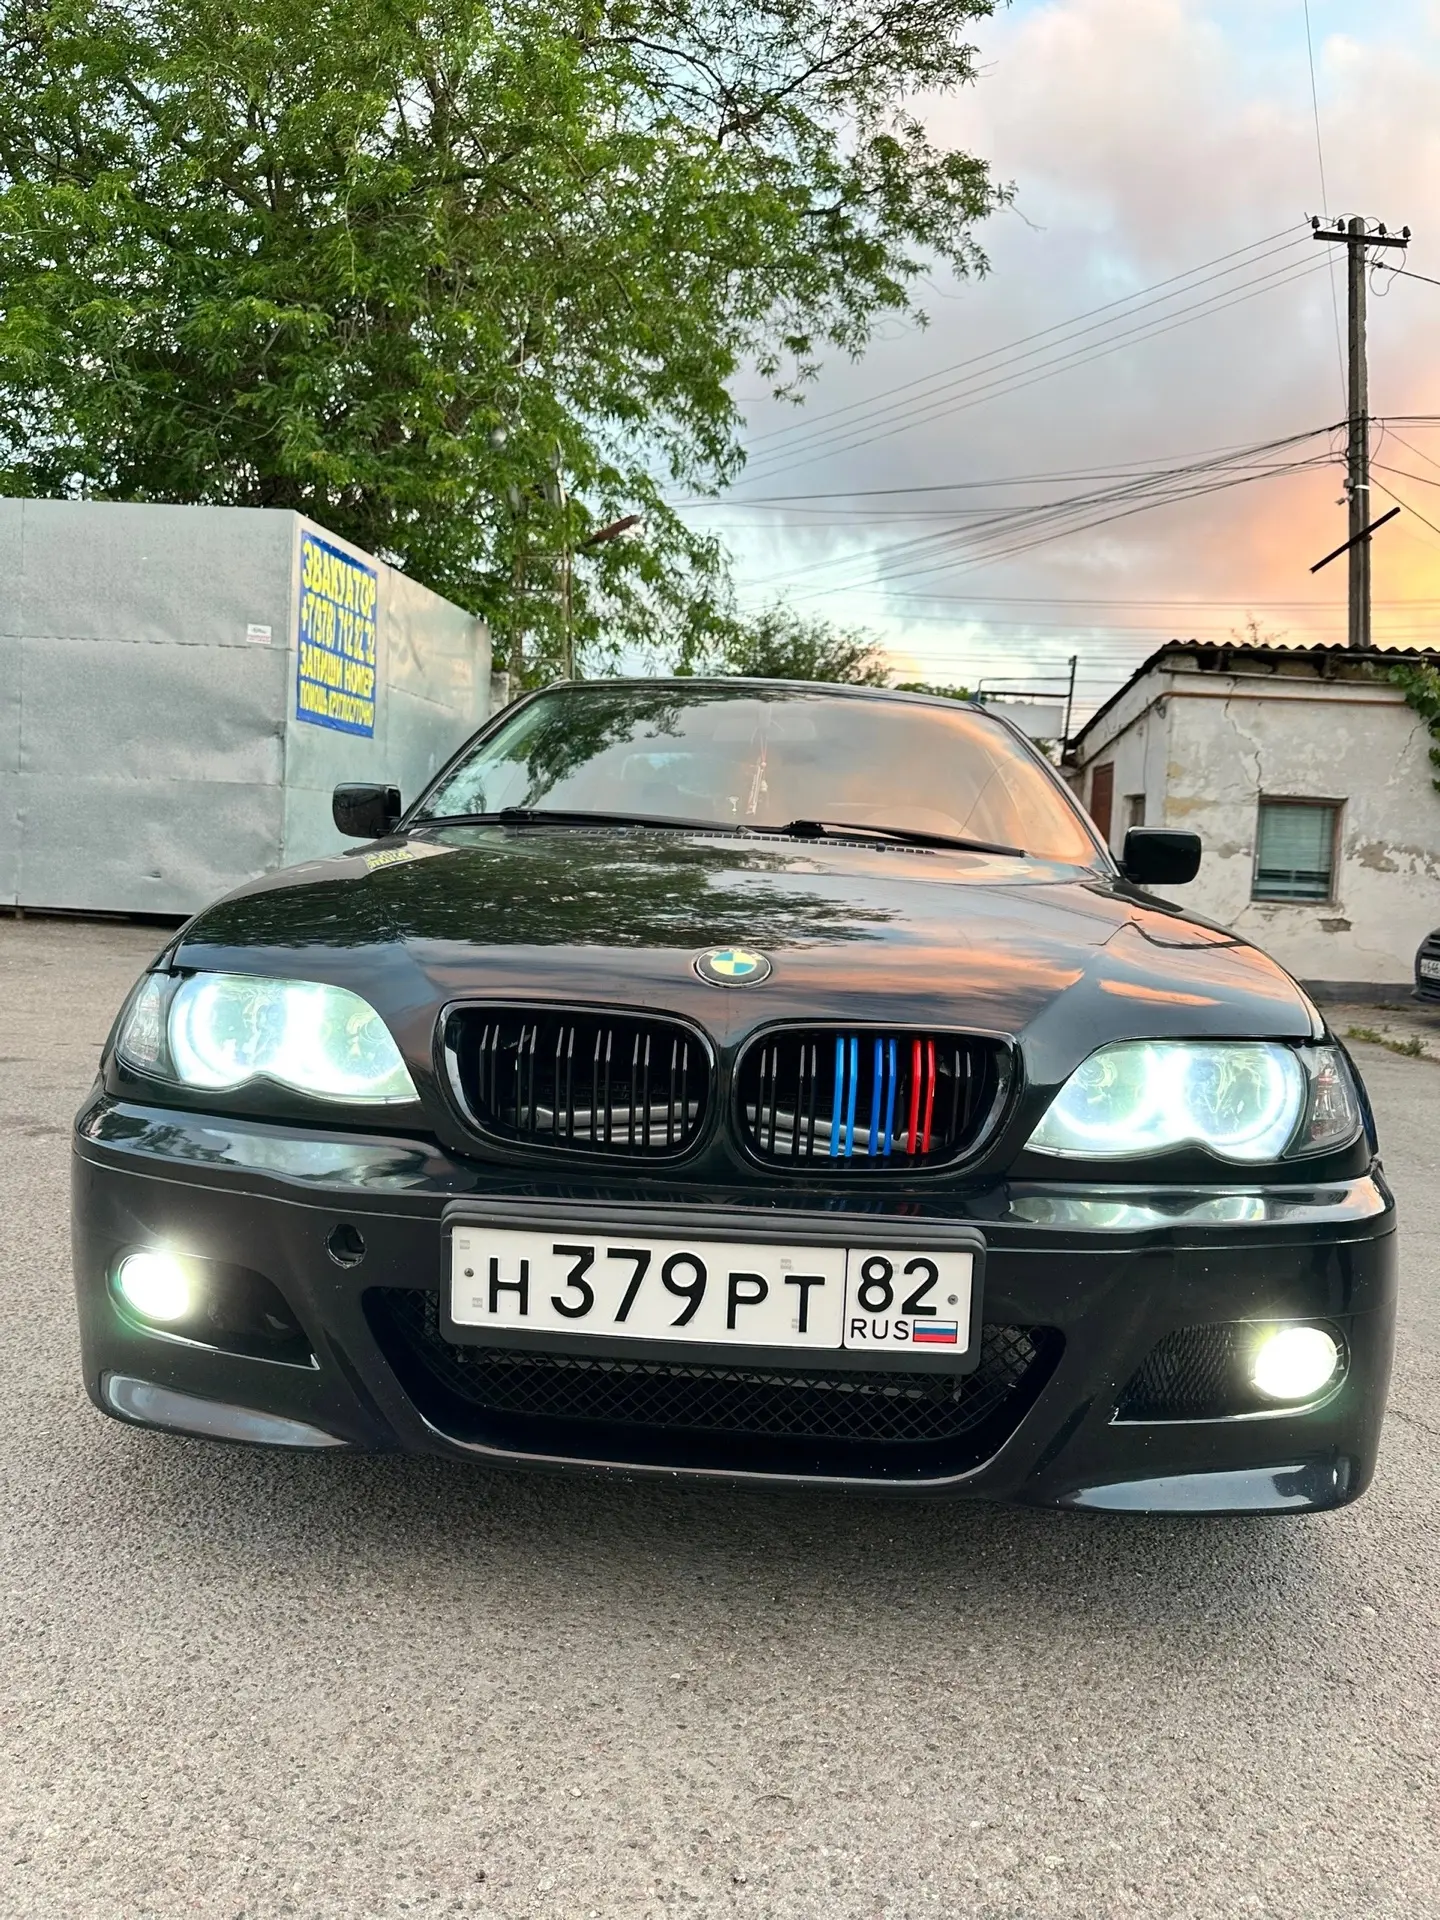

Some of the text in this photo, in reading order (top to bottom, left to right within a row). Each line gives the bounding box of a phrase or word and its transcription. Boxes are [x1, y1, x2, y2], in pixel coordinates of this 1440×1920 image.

[303, 540, 376, 620] ЭВАКУАТОР
[300, 641, 375, 699] ЗАПИШИ НОМЕР
[857, 1256, 939, 1315] 82
[850, 1319, 910, 1340] RUS
